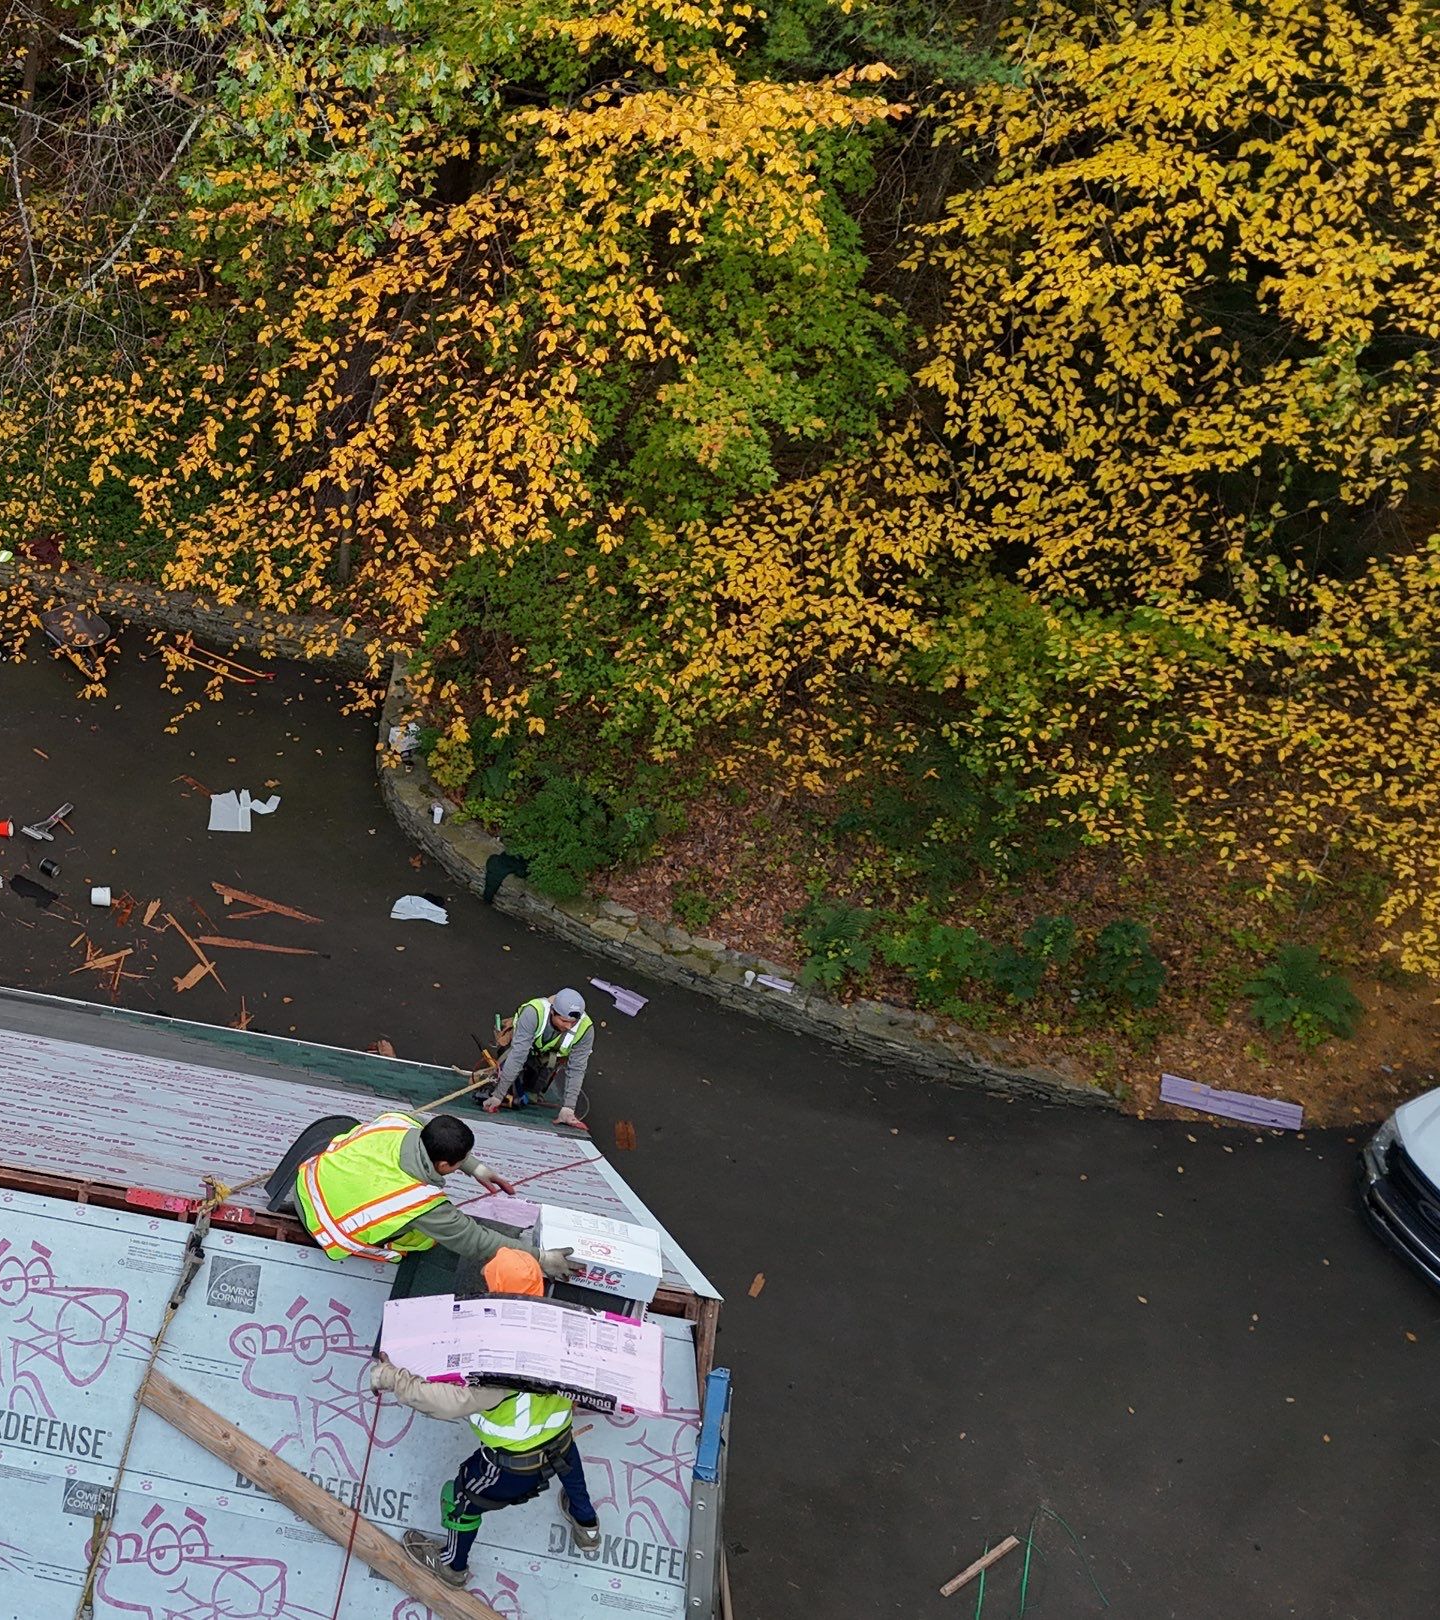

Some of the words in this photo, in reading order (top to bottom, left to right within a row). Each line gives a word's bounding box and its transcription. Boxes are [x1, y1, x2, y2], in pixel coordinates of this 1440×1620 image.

[220, 1283, 255, 1297] OWENS
[211, 1290, 254, 1306] CORNING
[556, 1388, 612, 1410] DURATION
[426, 1555, 436, 1568] N
